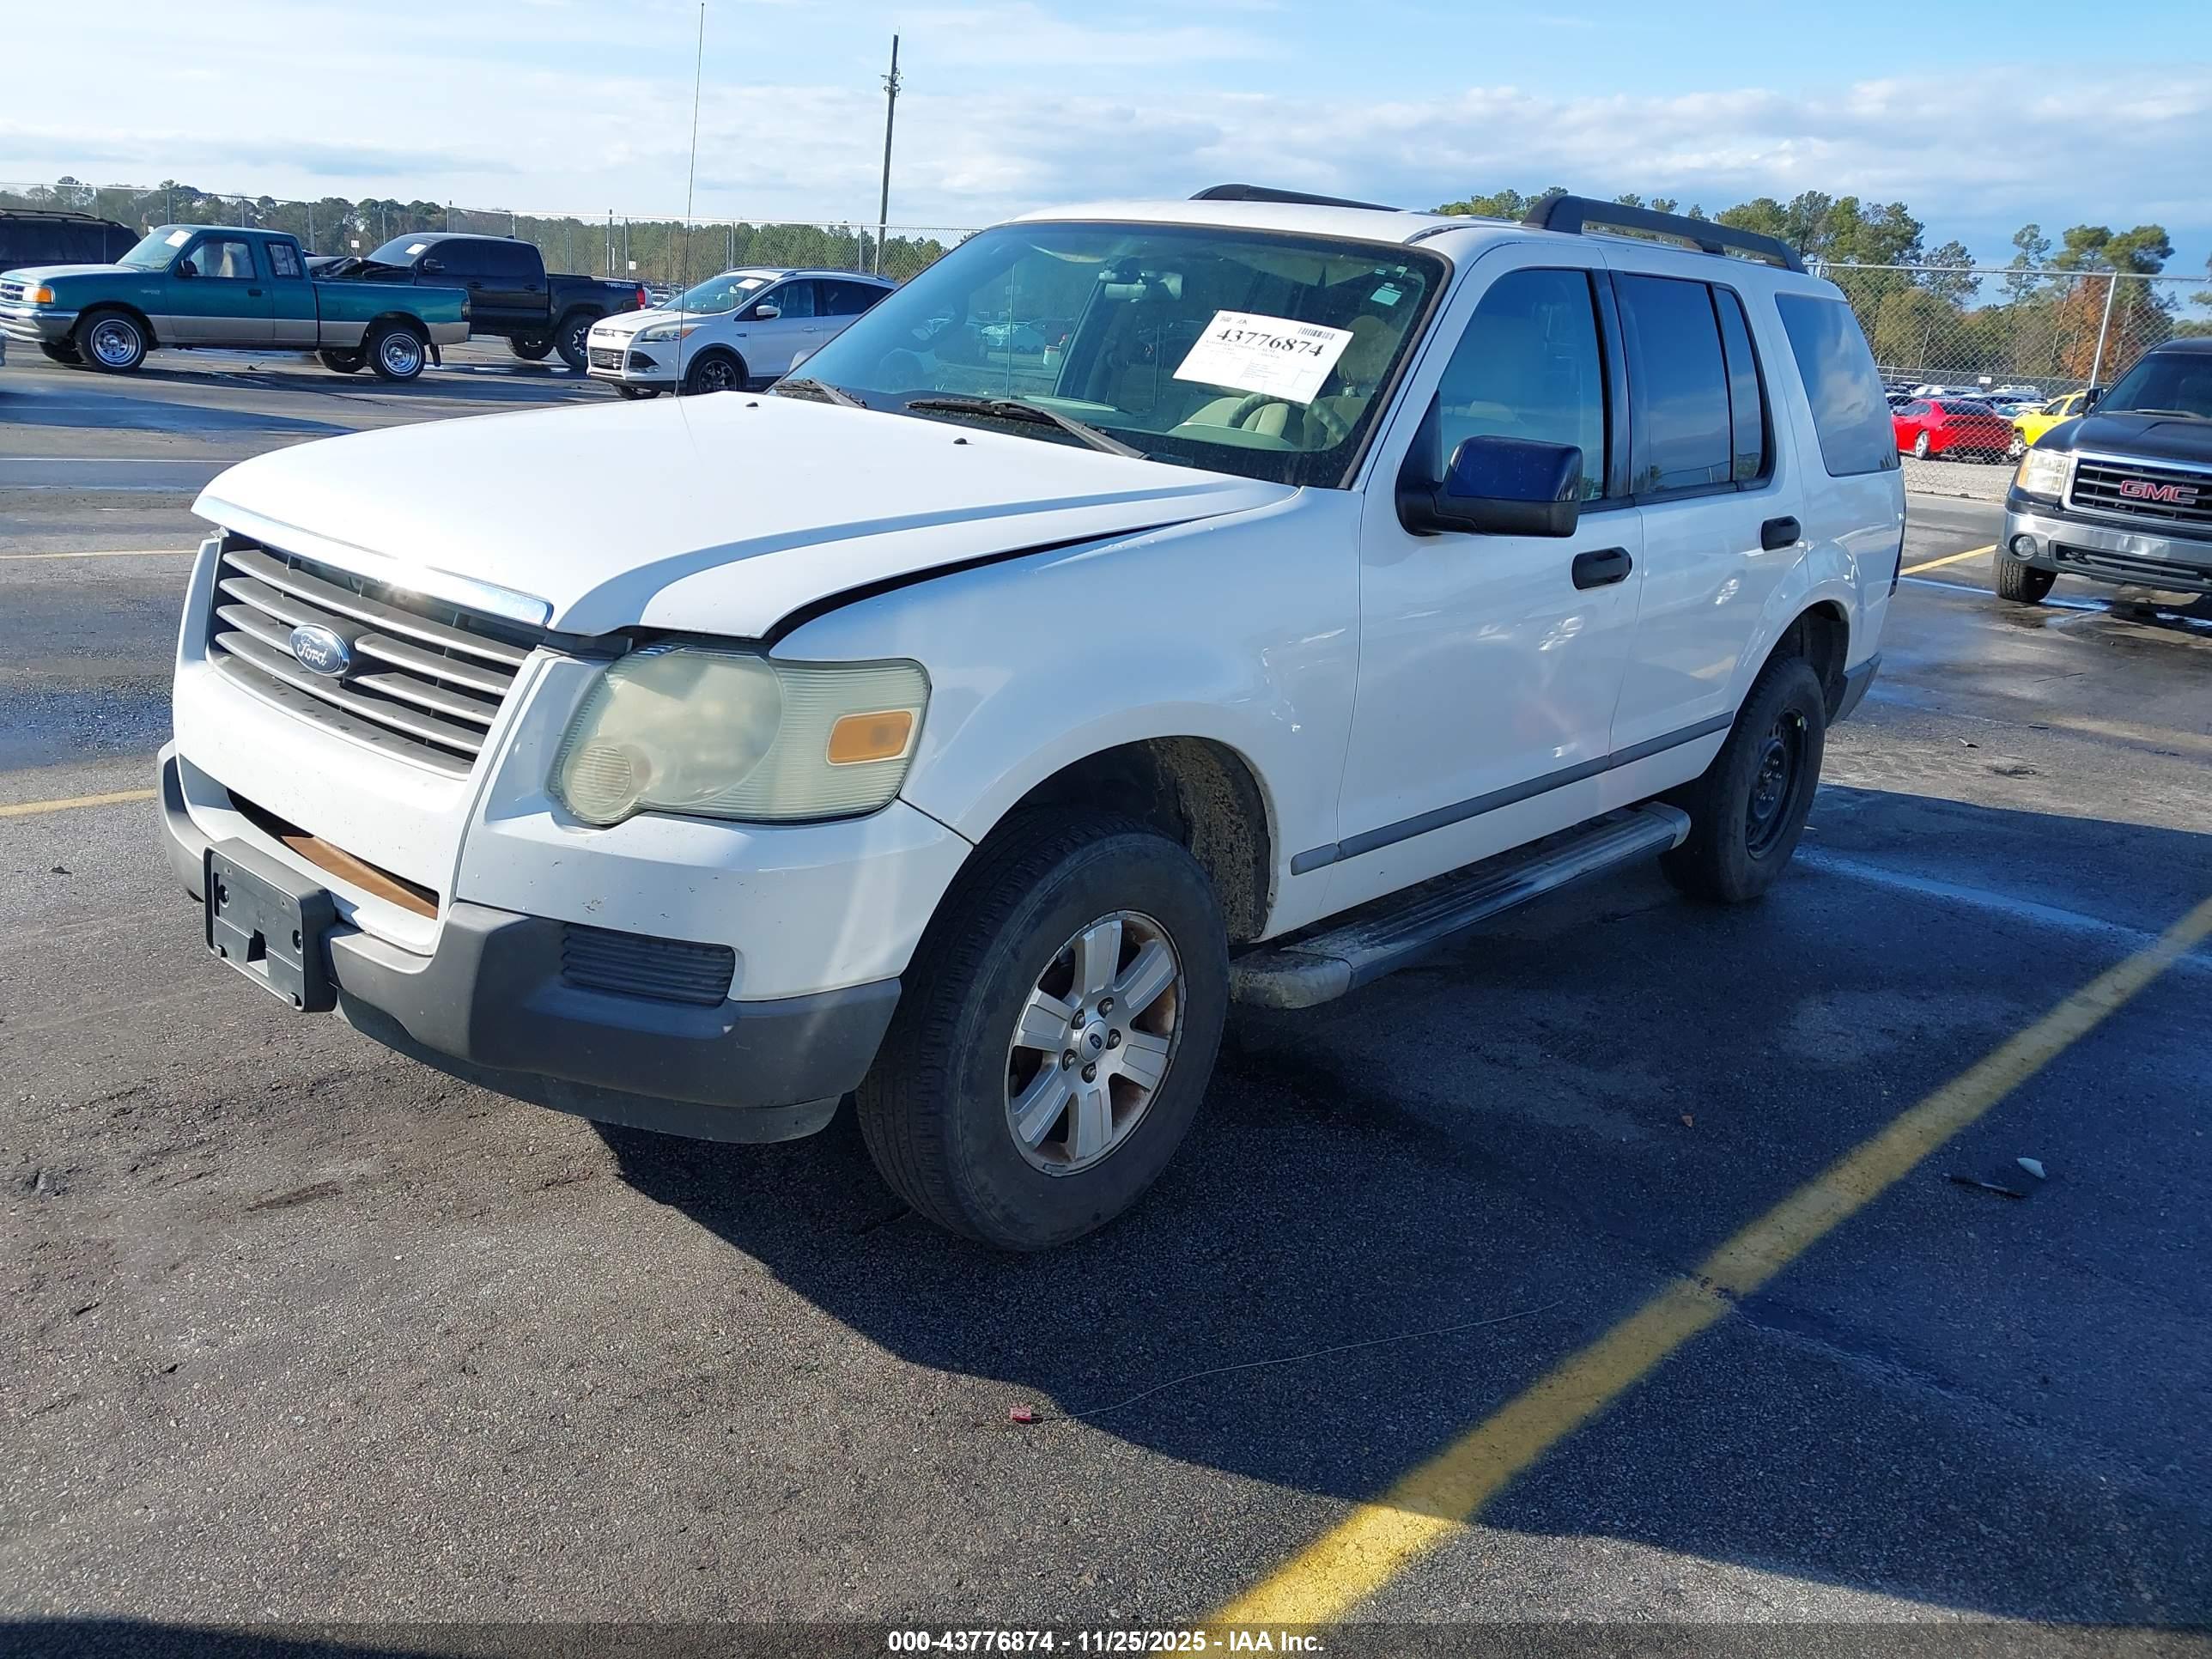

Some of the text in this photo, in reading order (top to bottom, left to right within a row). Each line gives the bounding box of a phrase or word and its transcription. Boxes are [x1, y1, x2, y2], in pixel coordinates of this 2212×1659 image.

[1217, 328, 1325, 357] 43776874
[2119, 480, 2199, 505] GMC
[296, 633, 329, 666] Ford
